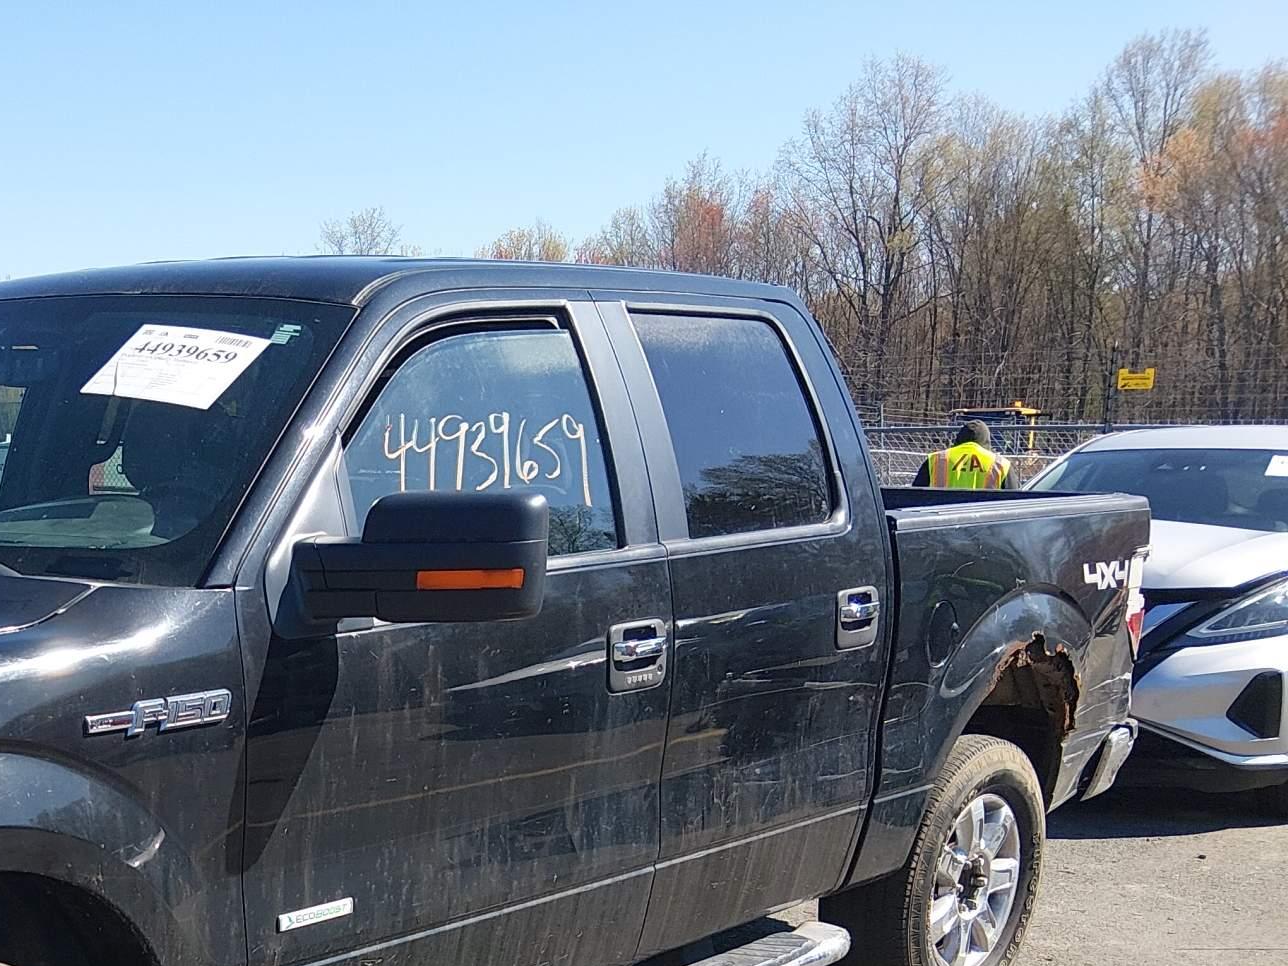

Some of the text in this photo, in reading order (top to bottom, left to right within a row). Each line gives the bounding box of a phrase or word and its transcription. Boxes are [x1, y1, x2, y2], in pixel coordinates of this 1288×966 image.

[135, 340, 238, 364] 44939659
[384, 412, 593, 508] 44939659
[127, 688, 232, 737] F-150
